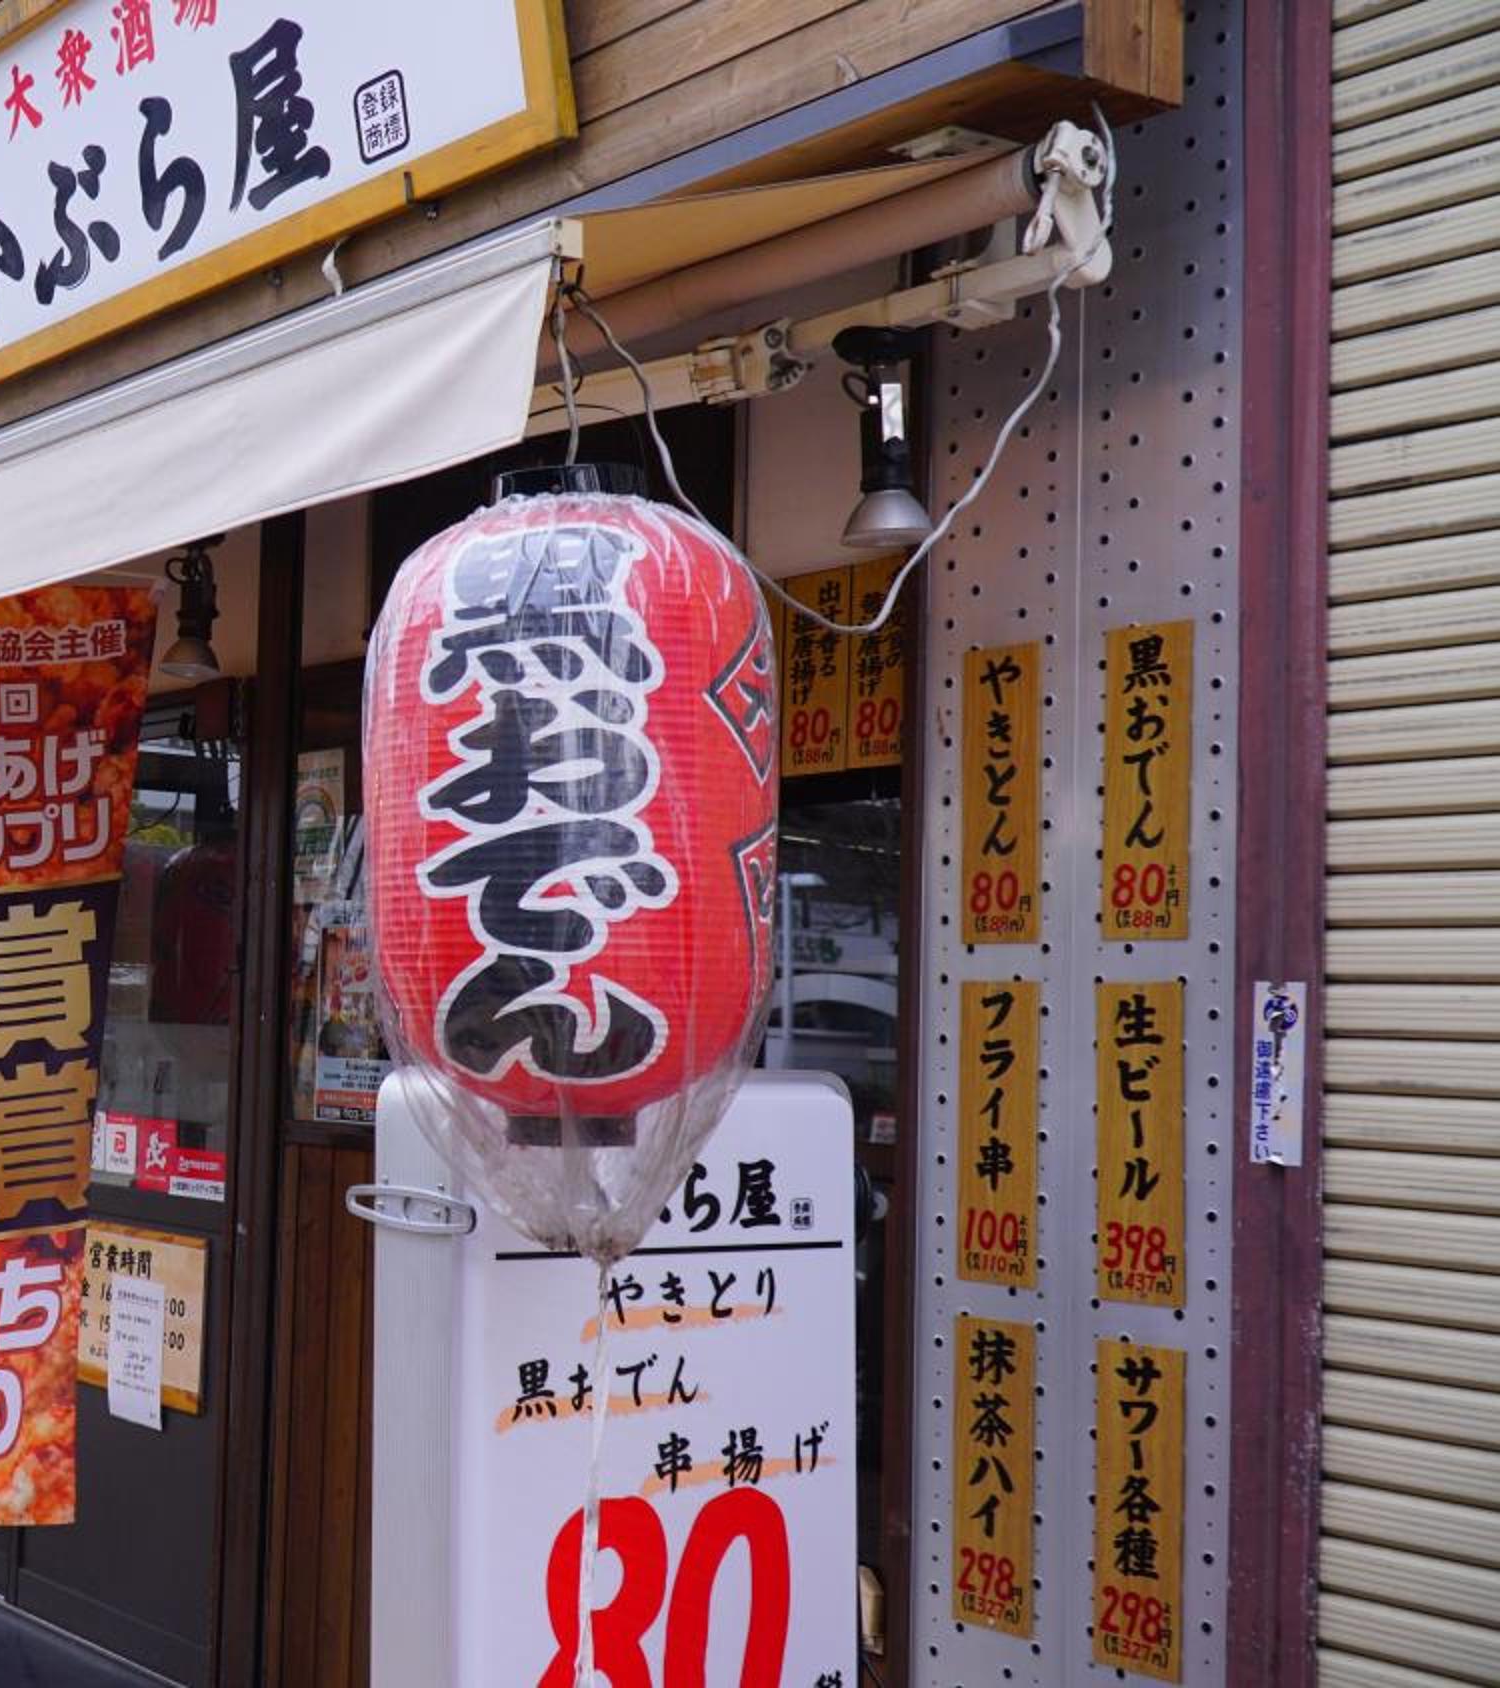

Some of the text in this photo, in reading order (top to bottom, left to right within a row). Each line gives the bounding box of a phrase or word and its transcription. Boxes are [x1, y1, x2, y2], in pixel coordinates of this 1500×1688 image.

[418, 521, 678, 1084] 黒おでん
[980, 655, 1022, 857] やきとん
[1123, 634, 1172, 849] 黒おでん
[970, 871, 1031, 914] 80円
[976, 992, 1015, 1192] フライ串
[1115, 994, 1164, 1202] 生ビール
[90, 1241, 152, 1279] 営業時間
[660, 1159, 781, 1232] ら屋
[1102, 1221, 1177, 1275] 398円
[605, 1267, 776, 1326] やきとり
[653, 1421, 830, 1494] 串揚げ
[968, 1330, 1017, 1538] 抹茶ハイ
[1114, 1356, 1162, 1580] サワー各種
[957, 1547, 1023, 1605] 298円
